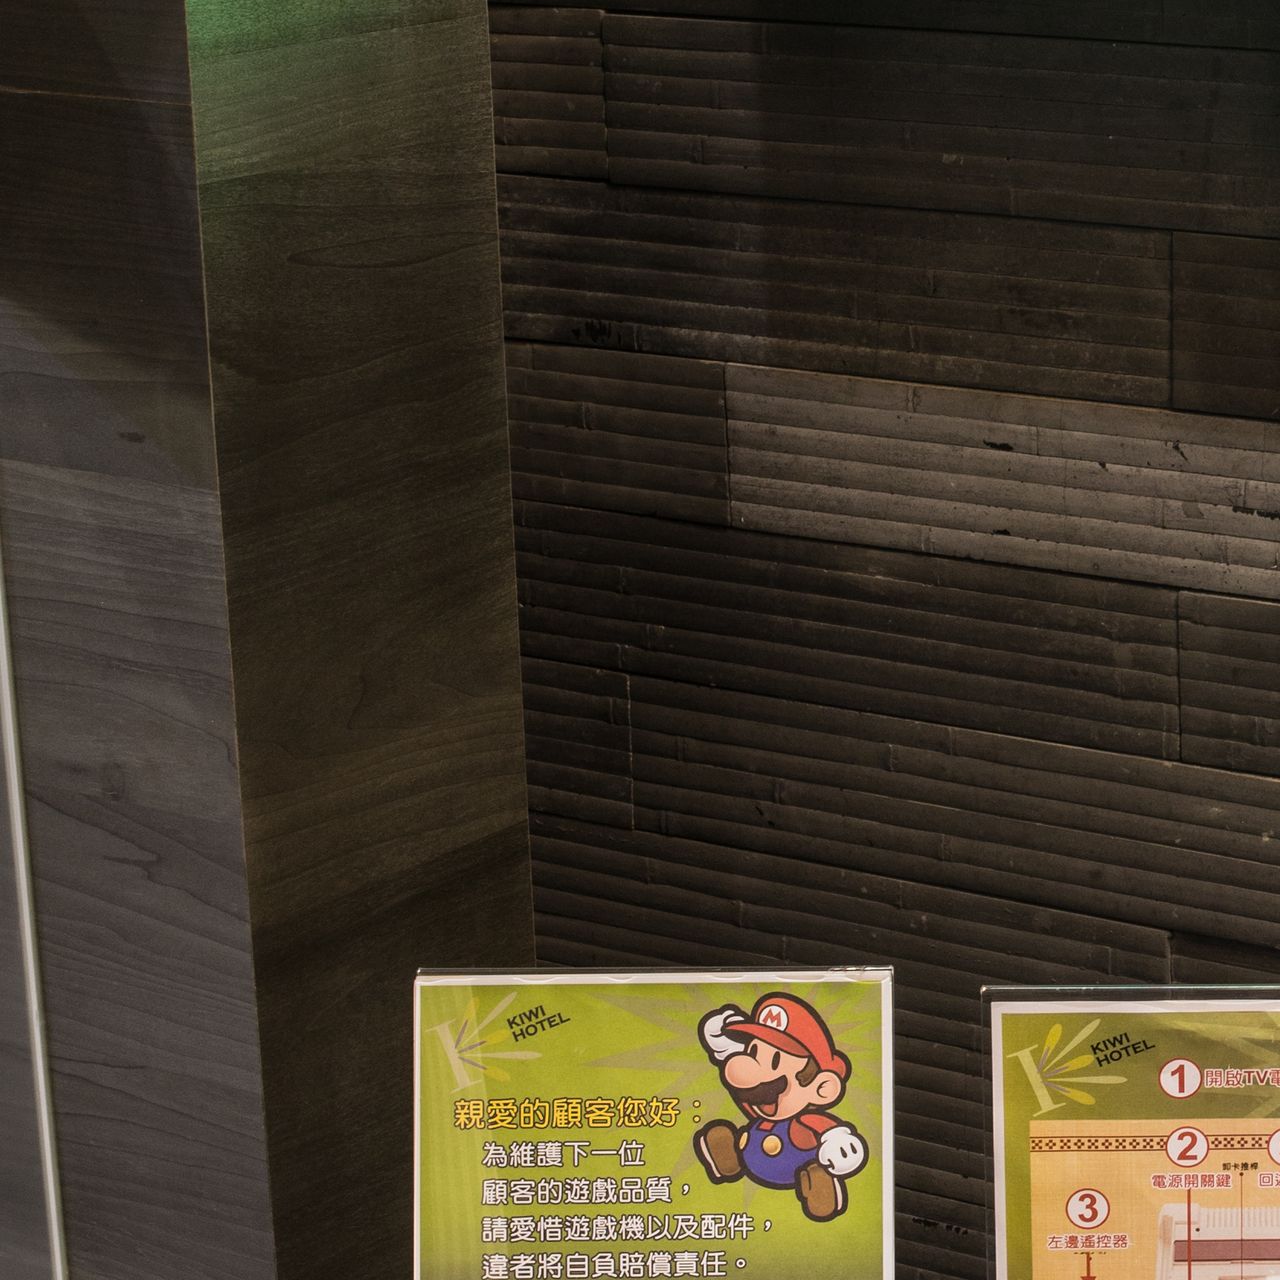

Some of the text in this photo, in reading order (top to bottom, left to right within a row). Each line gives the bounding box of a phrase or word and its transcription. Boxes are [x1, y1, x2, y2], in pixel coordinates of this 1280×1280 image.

[506, 1004, 546, 1030] KIWI
[511, 1011, 571, 1043] HOTEL
[1090, 1031, 1130, 1055] KIWI
[1096, 1038, 1156, 1068] HOTEL
[482, 1140, 646, 1168] 為維護下一位
[481, 1176, 691, 1206] 顧客的遊戲品質，
[1151, 1174, 1232, 1189] 電源開關鍵
[1048, 1234, 1128, 1249] 左邊遙控器
